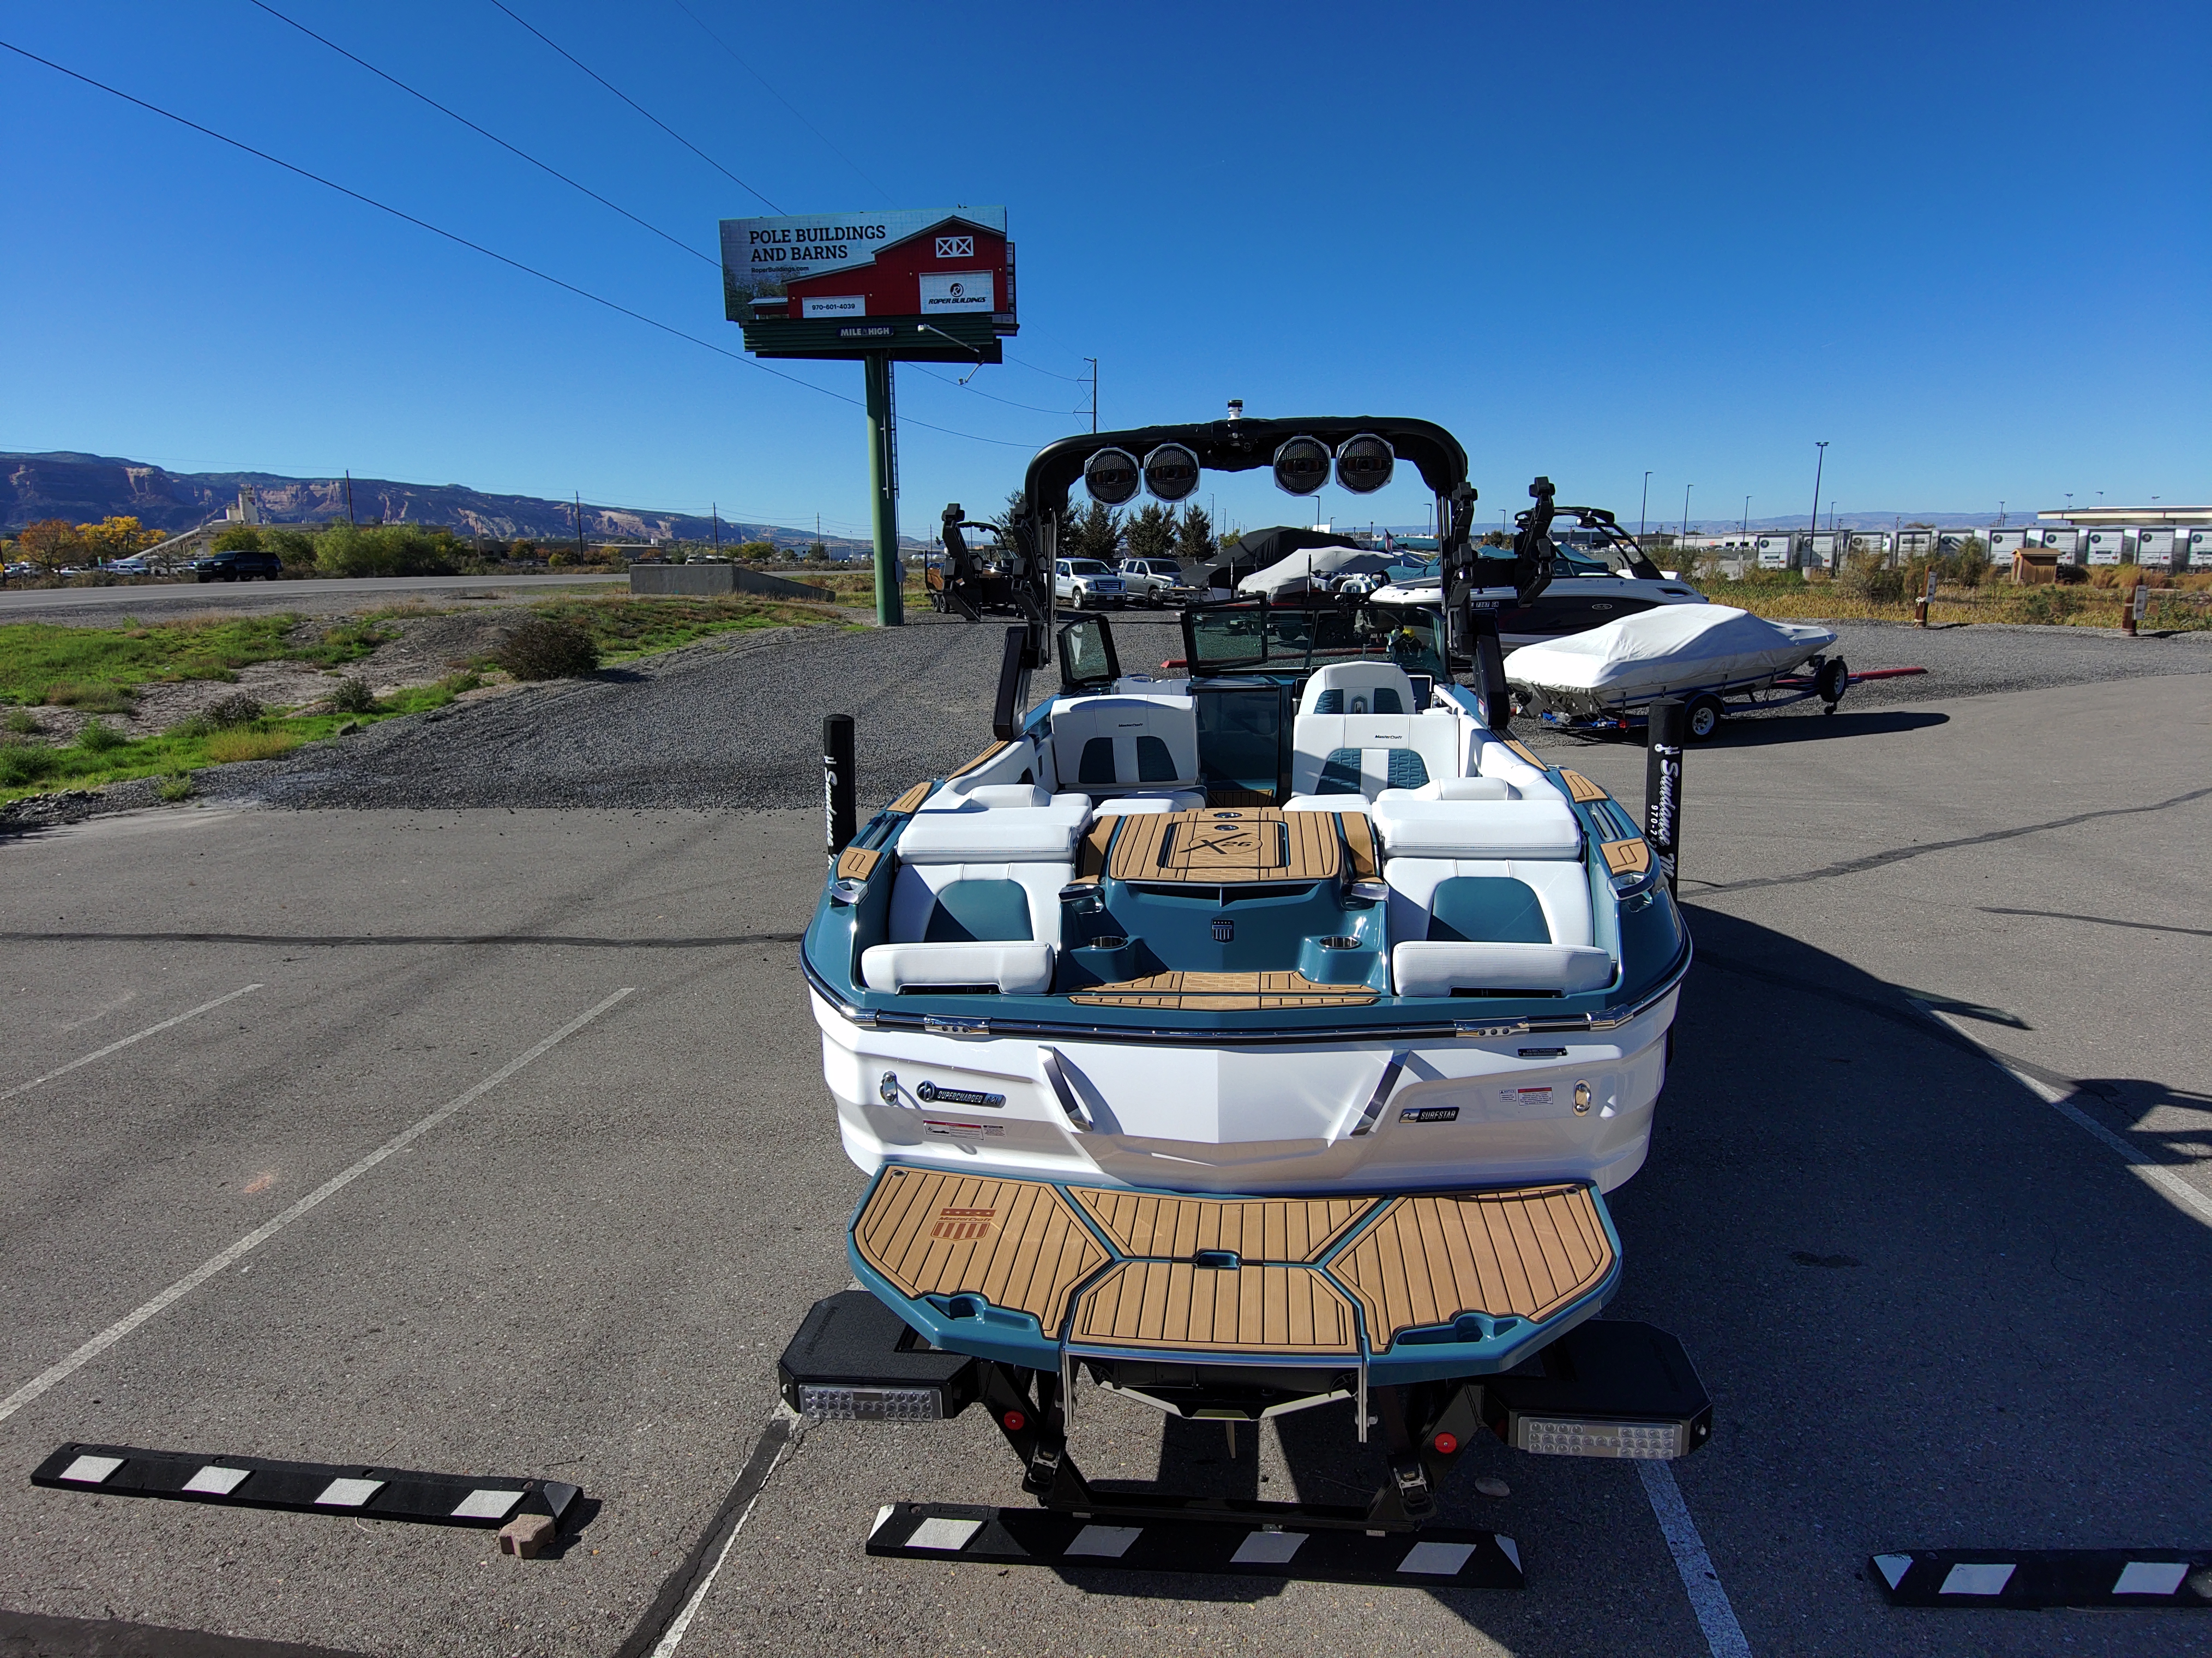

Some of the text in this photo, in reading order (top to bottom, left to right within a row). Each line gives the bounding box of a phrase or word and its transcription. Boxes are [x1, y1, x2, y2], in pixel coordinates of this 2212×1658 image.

[749, 225, 886, 244] POLE BUILDINGS
[750, 245, 848, 262] AND BARNS
[868, 327, 889, 335] HIGH
[825, 767, 838, 847] Sundance
[1658, 759, 1679, 846] Sundance
[937, 1091, 983, 1103] SUPERCHARGED
[1420, 1110, 1456, 1120] SURFSTAR
